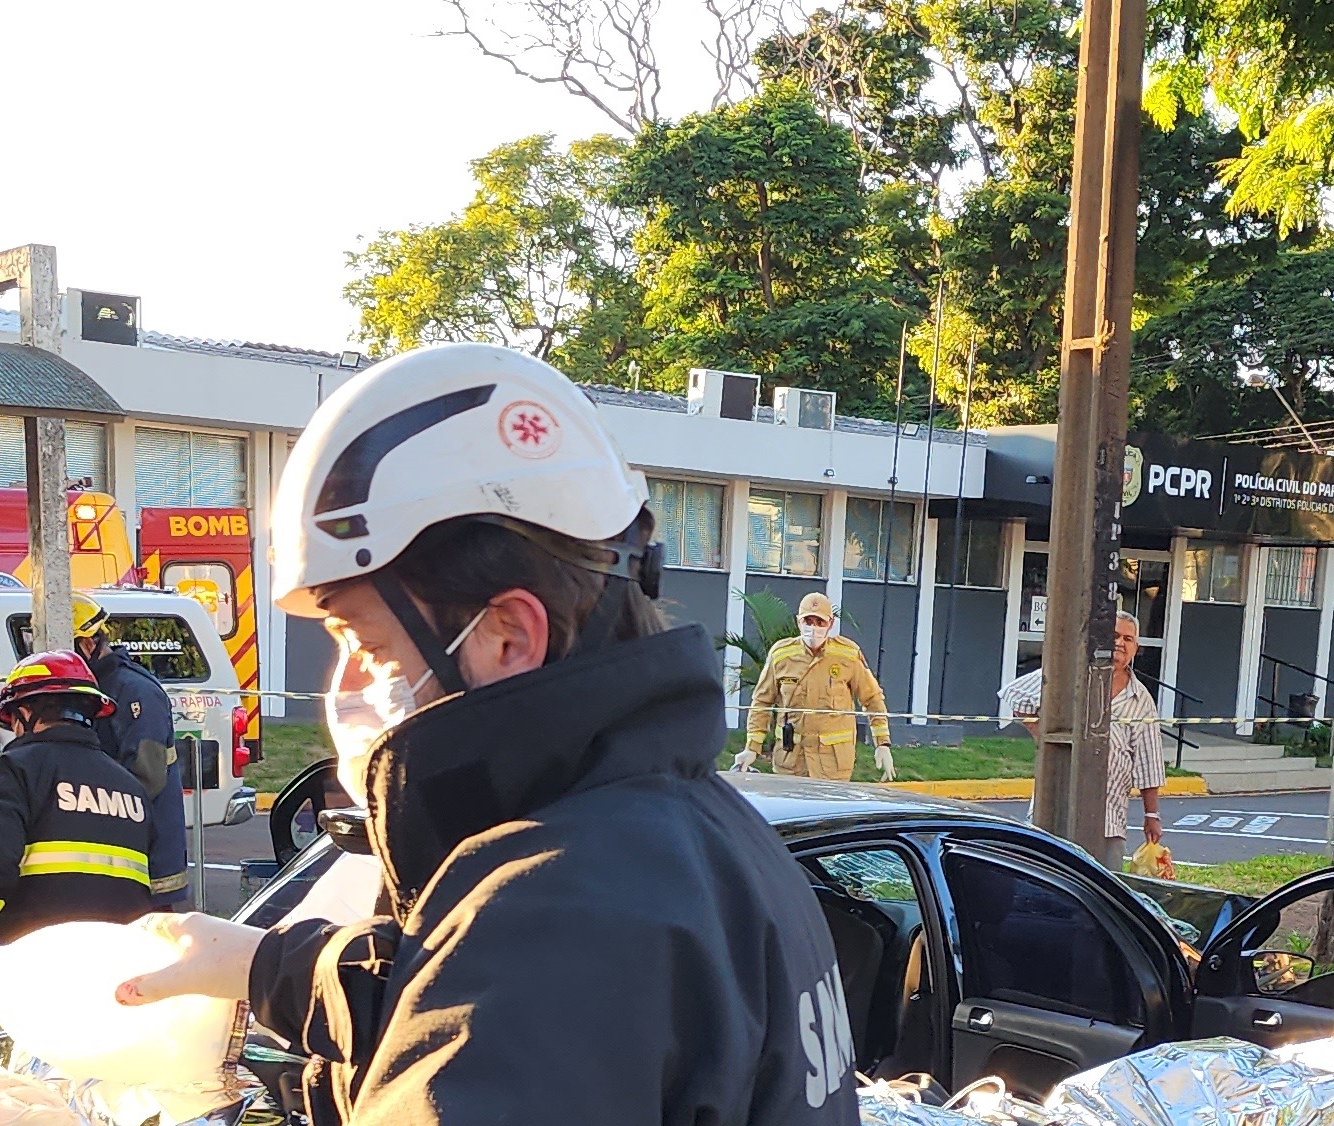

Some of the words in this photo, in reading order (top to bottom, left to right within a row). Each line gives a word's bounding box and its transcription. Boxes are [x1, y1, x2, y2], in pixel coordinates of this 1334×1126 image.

[1148, 464, 1212, 499] PCPR
[1235, 472, 1274, 491] POLÍCIA
[1276, 478, 1300, 493] CIVIL
[1303, 481, 1316, 495] DO
[1260, 496, 1296, 509] DISTRITOS
[169, 515, 248, 537] BOMB
[180, 694, 223, 709] RÁPIDA
[56, 781, 145, 822] SAMU
